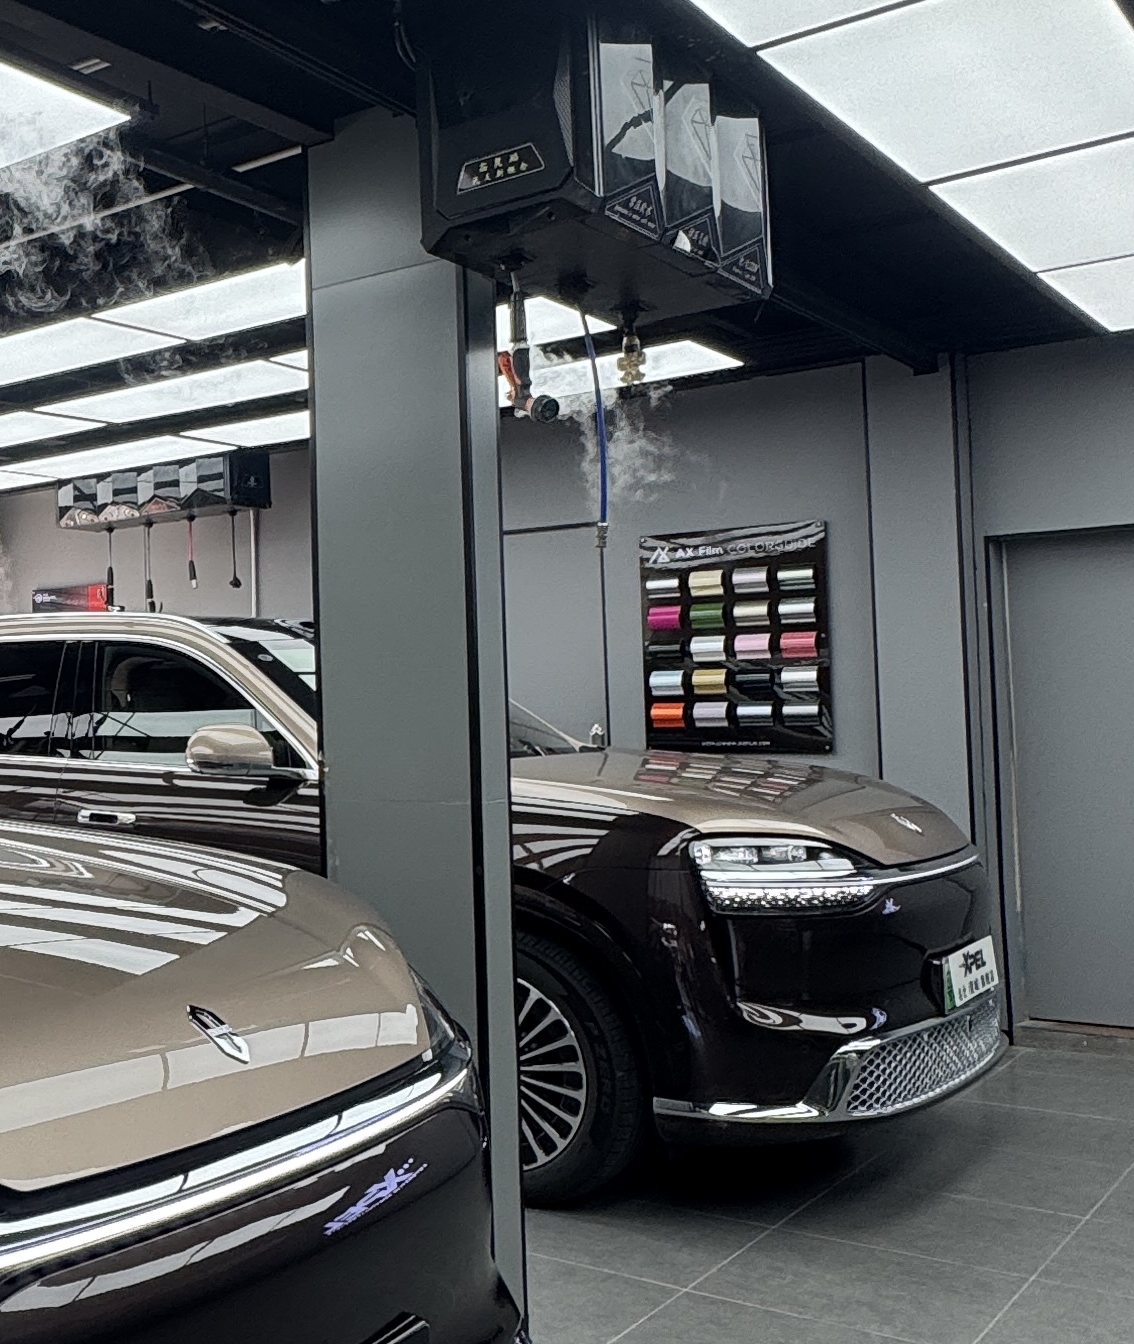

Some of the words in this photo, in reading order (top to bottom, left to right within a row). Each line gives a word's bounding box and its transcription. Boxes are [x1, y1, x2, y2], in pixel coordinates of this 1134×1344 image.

[676, 548, 695, 558] AX
[699, 545, 723, 557] Film
[962, 949, 986, 978] XPEL
